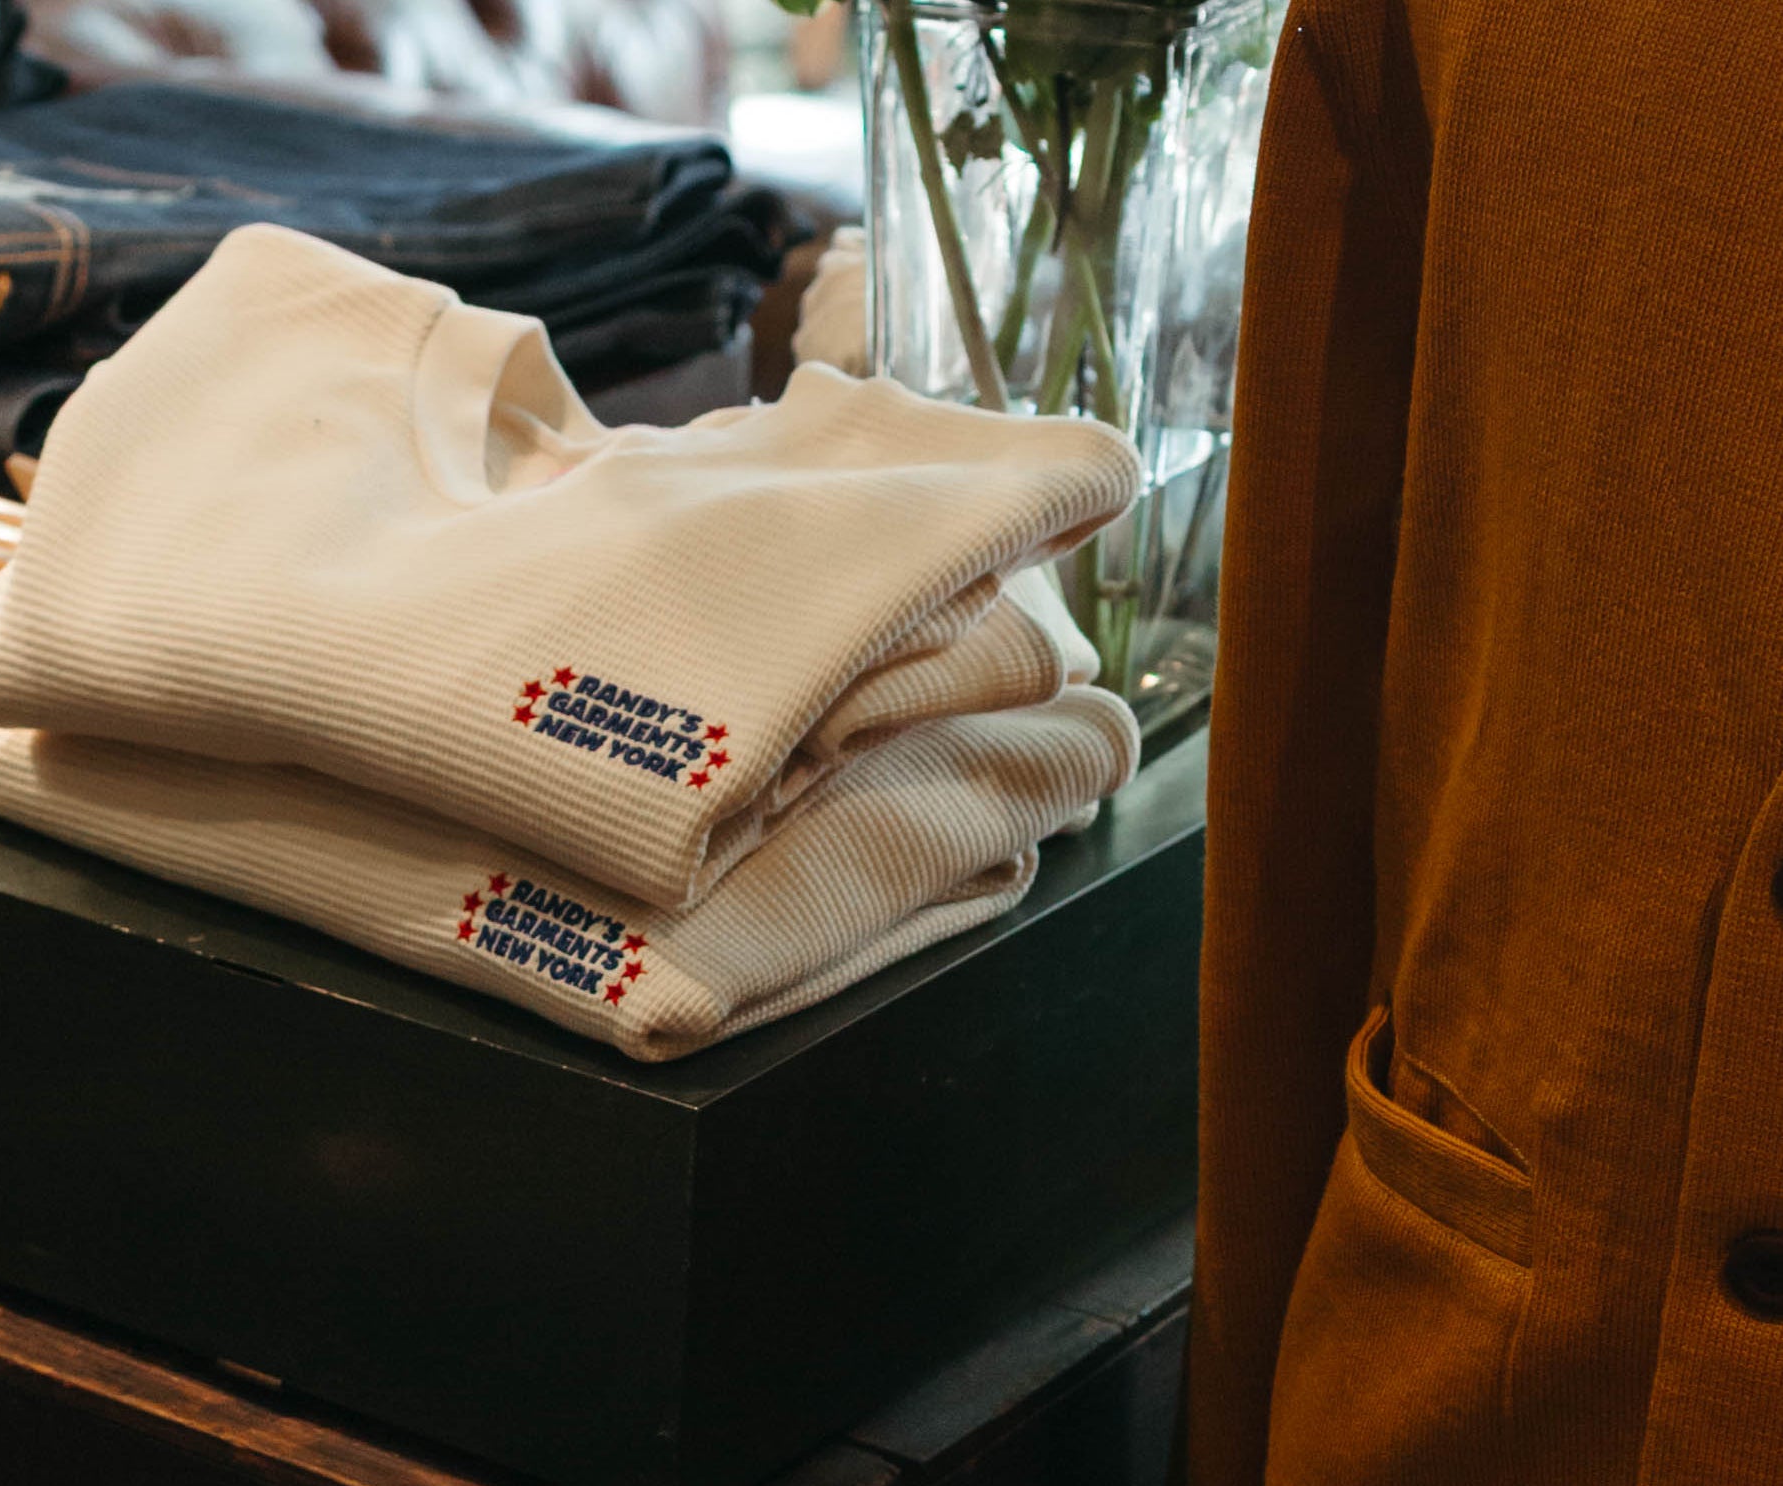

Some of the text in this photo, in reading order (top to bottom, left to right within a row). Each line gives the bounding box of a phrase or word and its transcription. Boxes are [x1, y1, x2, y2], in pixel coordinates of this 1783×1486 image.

[547, 691, 706, 761] GARMENTS
[575, 675, 704, 734] RANDY'S
[534, 713, 687, 783] NEW YORK
[485, 899, 625, 971] GARMENTS
[510, 879, 626, 943] RANDY'S
[475, 924, 604, 995] NEW YORK
